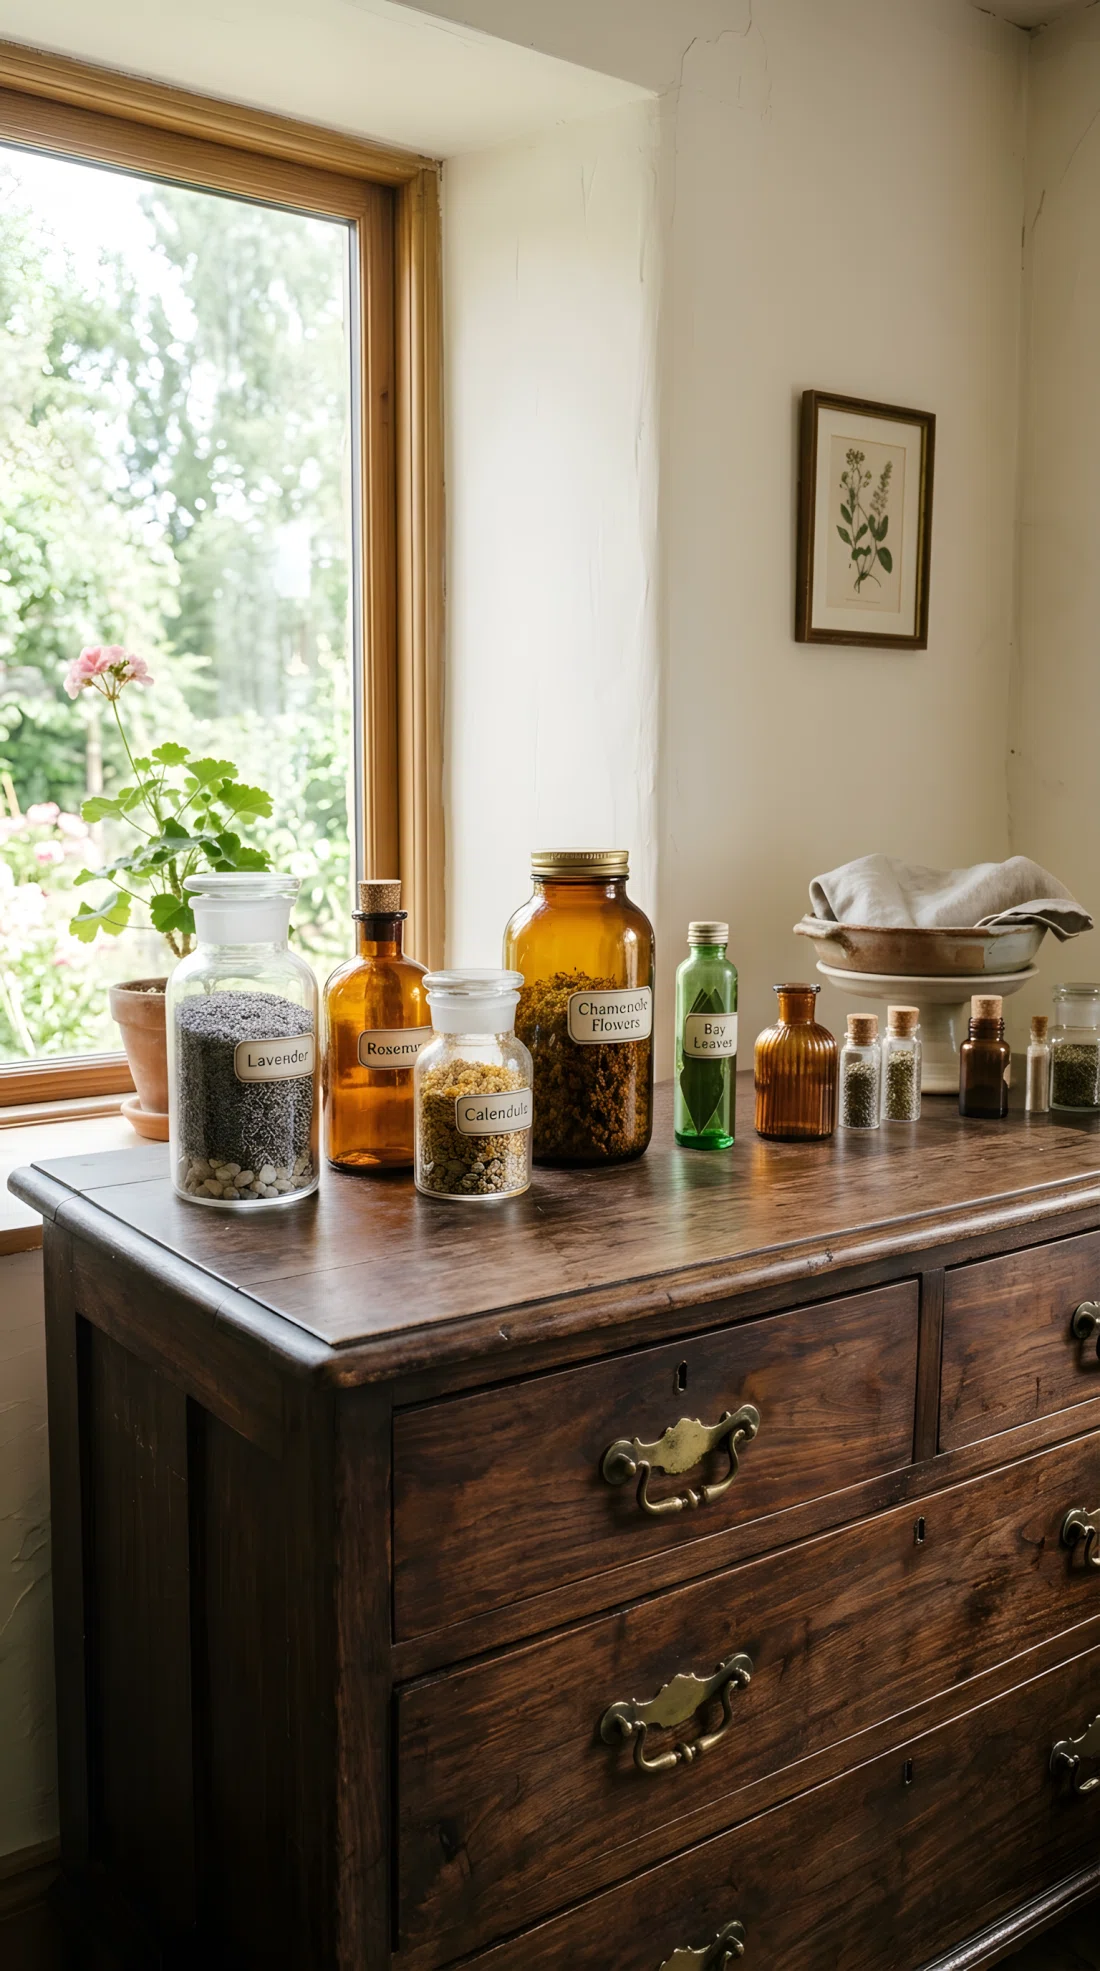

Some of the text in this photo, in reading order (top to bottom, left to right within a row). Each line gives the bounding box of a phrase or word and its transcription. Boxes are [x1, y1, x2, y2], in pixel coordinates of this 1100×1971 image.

[592, 1018, 642, 1033] Flowers
[704, 1023, 726, 1037] Bay
[247, 1049, 309, 1068] Lavender
